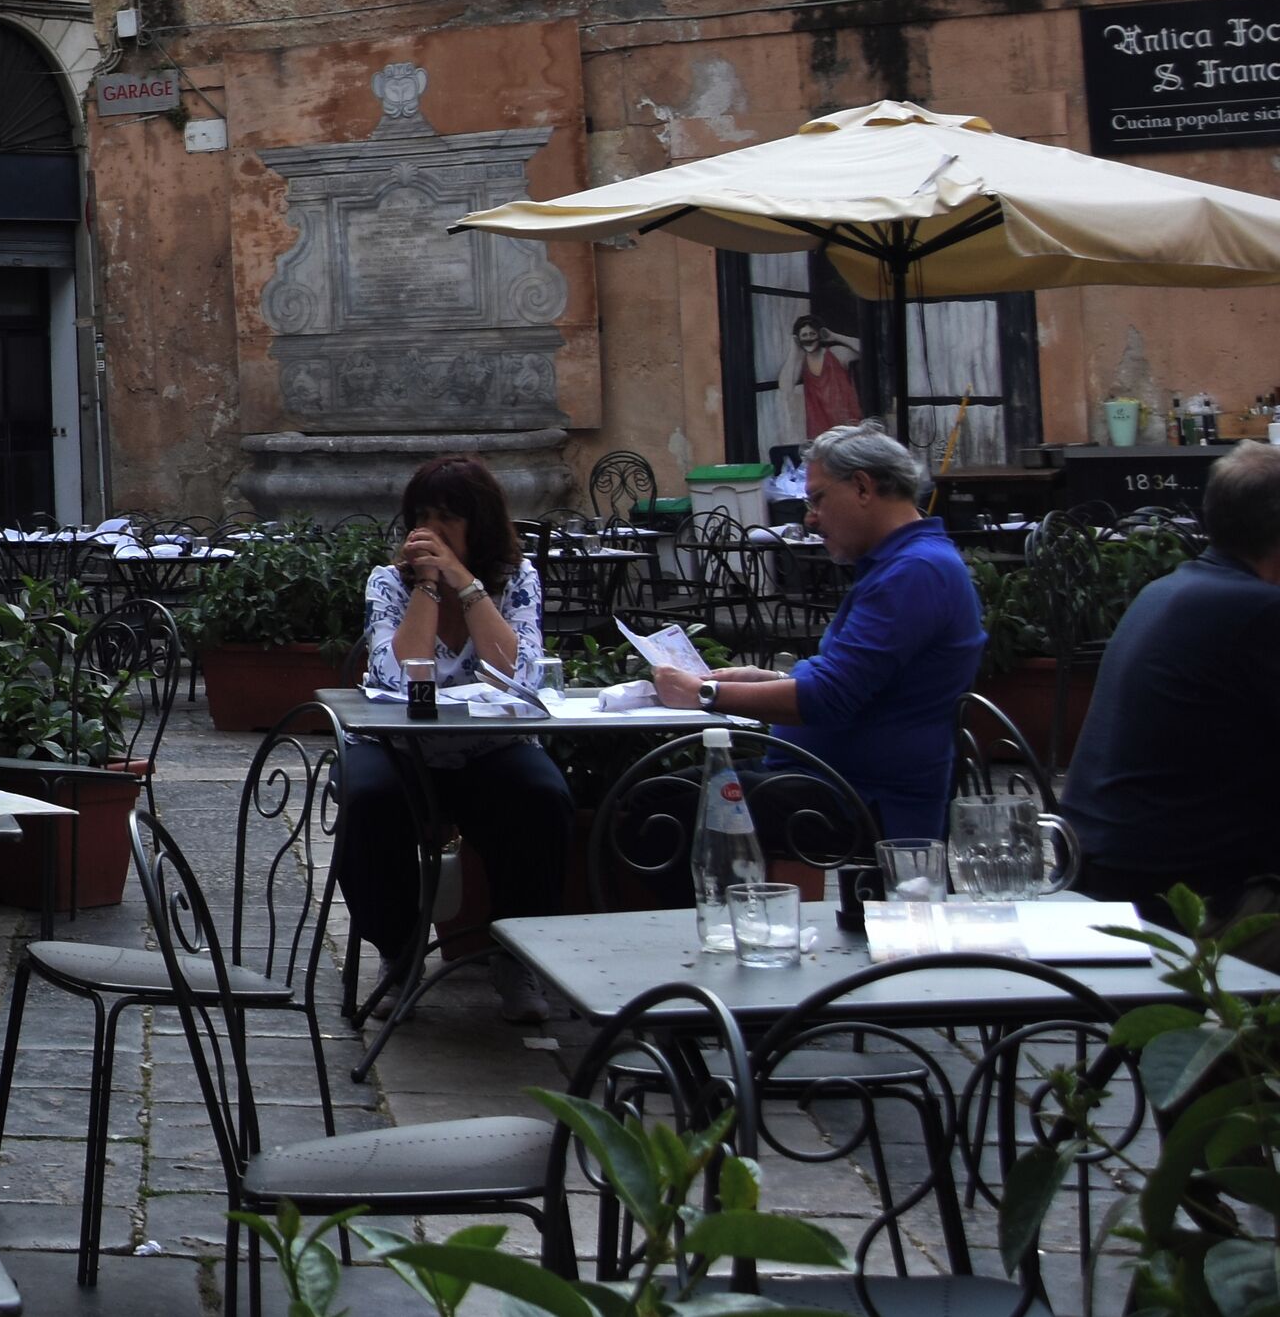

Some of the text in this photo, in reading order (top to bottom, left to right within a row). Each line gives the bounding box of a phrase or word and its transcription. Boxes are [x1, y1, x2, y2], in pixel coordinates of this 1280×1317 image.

[1104, 24, 1213, 55] Antica
[1152, 63, 1185, 92] S.
[103, 80, 174, 101] GARAGE
[1111, 114, 1172, 130] Cucina
[1176, 108, 1250, 132] popolare
[411, 683, 433, 703] 12
